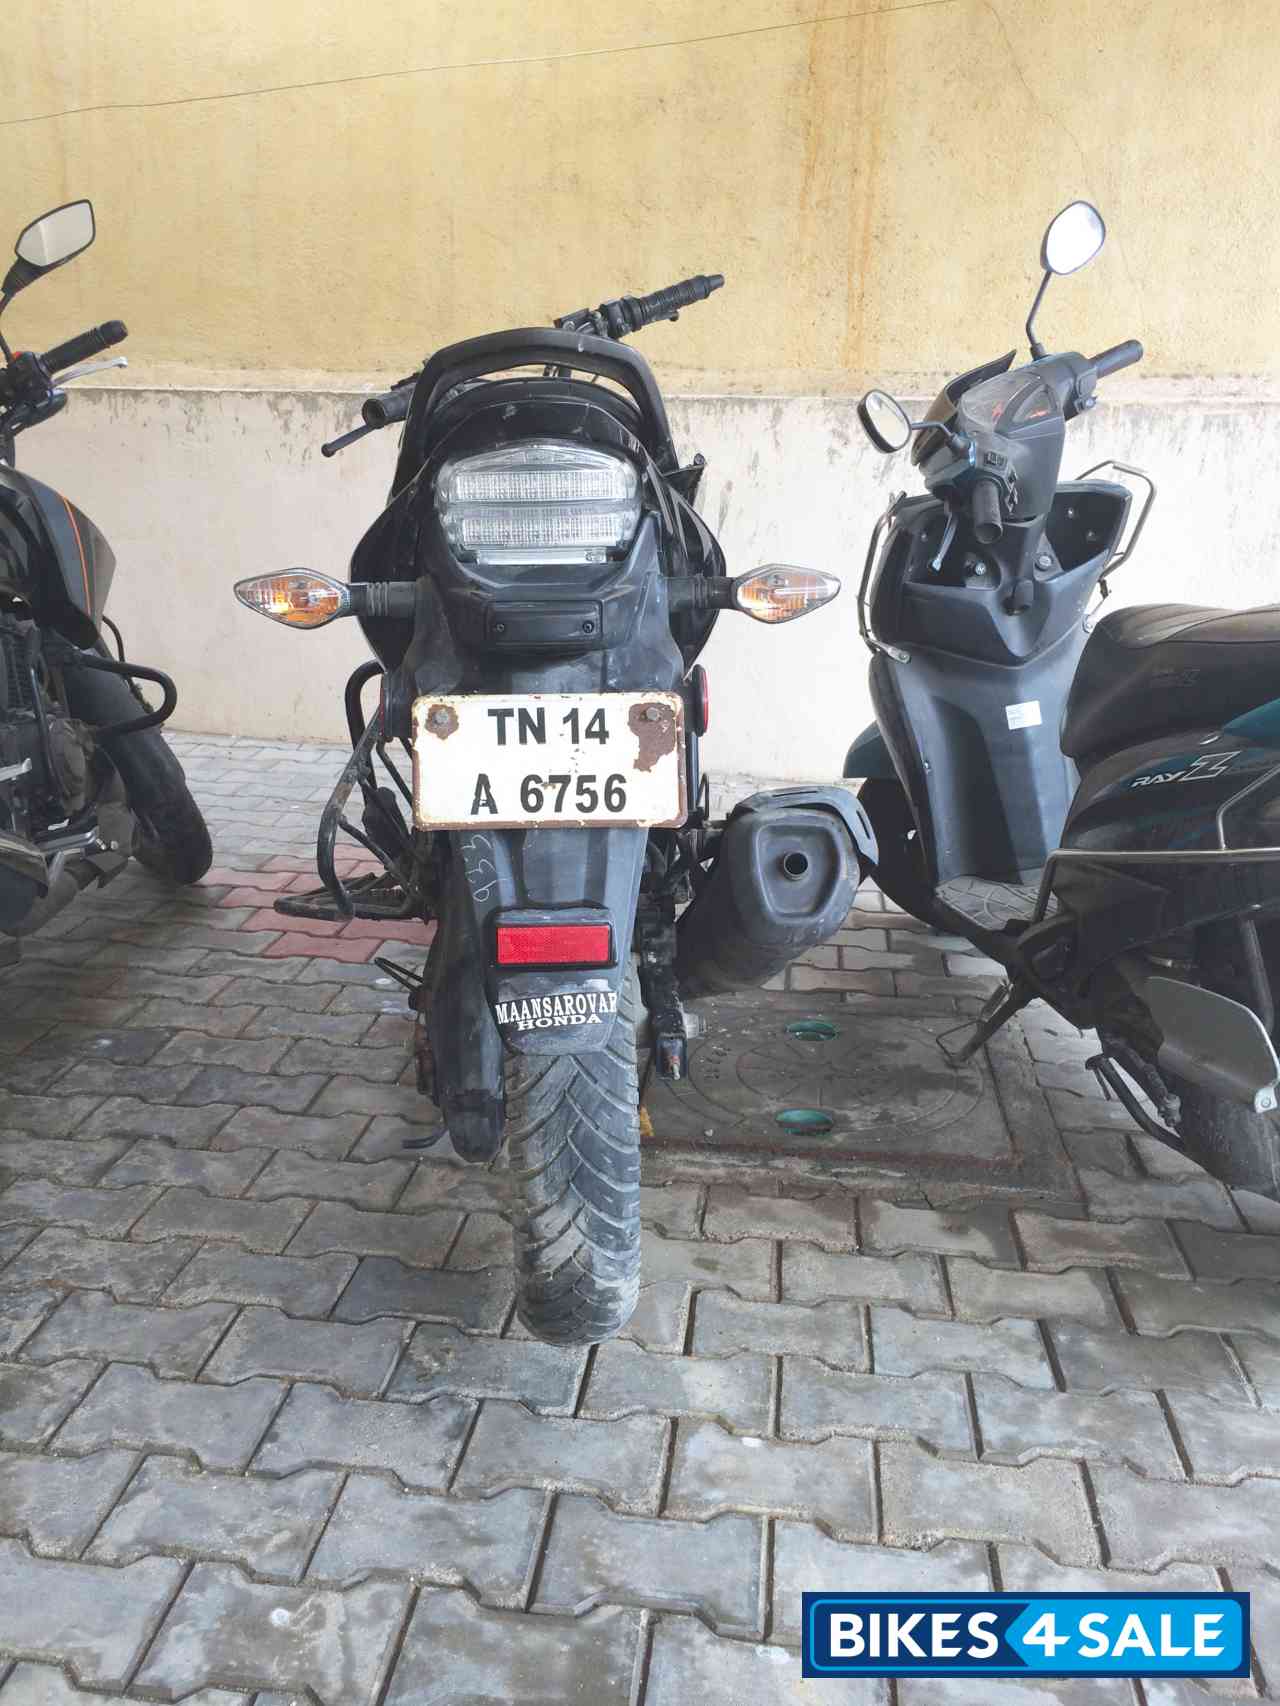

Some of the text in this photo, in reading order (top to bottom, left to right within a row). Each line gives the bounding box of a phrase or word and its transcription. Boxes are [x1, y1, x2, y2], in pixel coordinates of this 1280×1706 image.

[487, 707, 610, 746] TN 14
[470, 773, 627, 815] A 6756
[516, 1013, 602, 1031] HONDA
